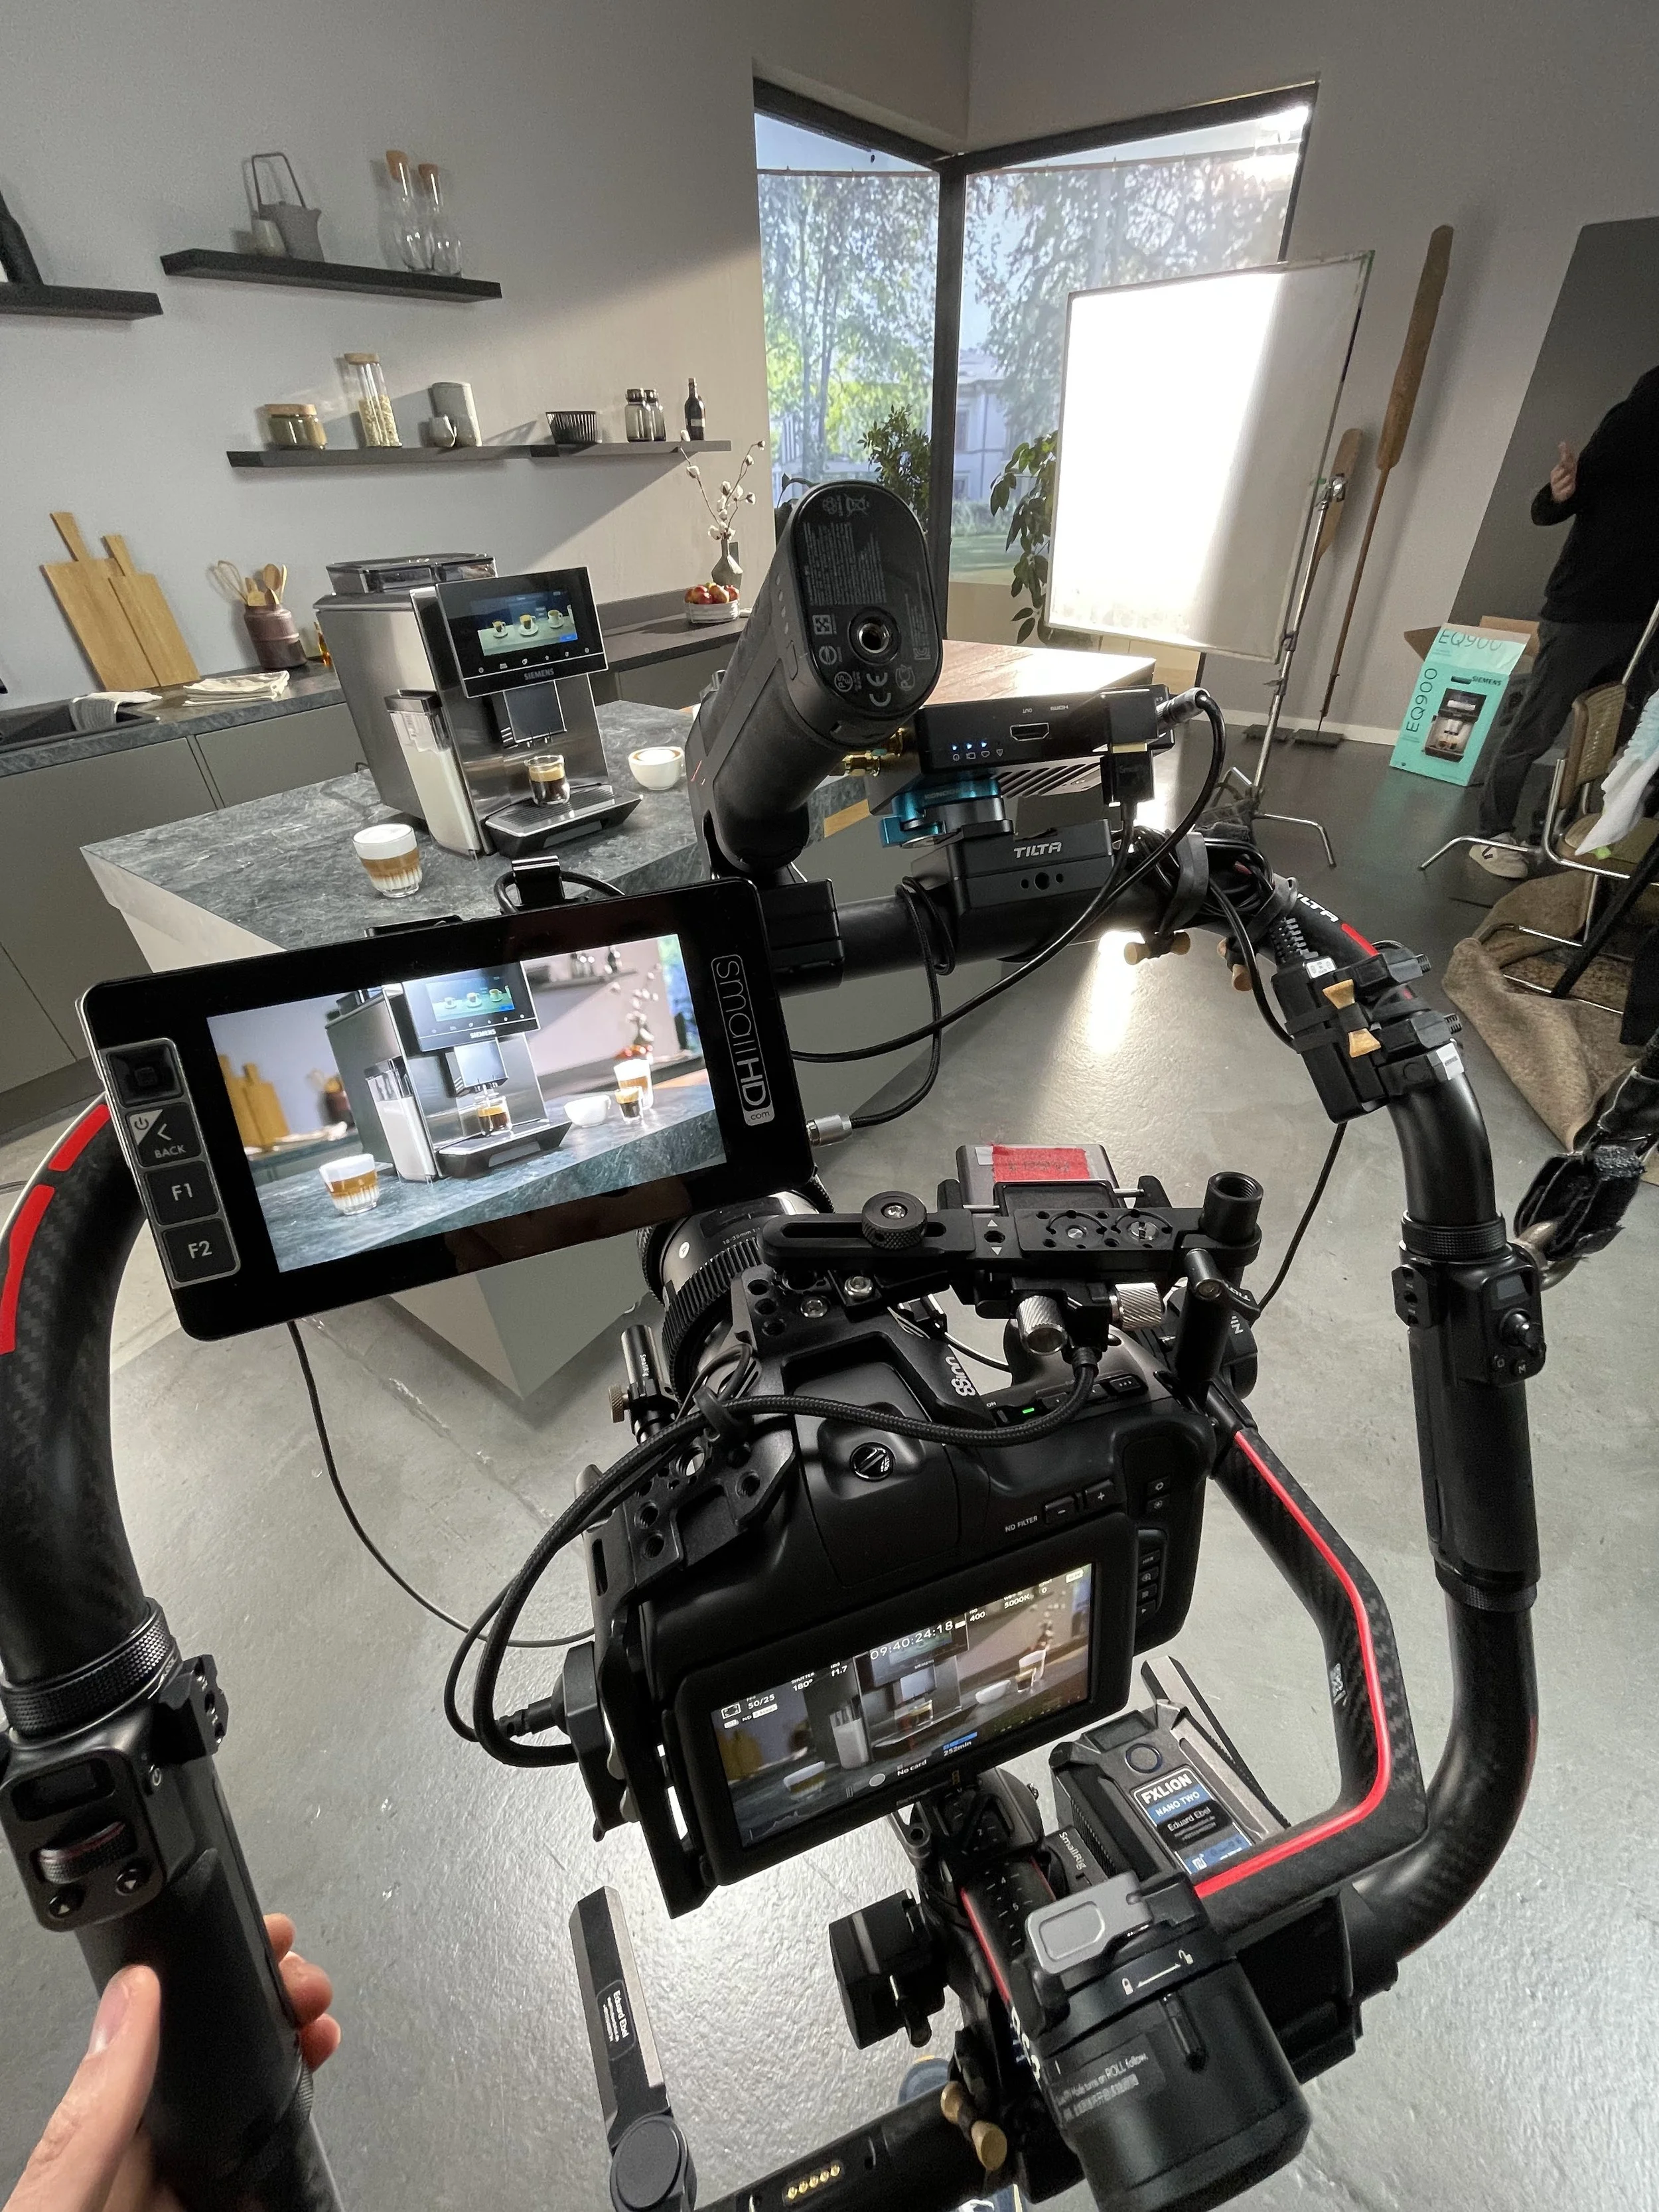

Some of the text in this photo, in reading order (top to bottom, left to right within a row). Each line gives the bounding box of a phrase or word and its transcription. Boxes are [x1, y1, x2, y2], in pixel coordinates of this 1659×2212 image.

[524, 668, 555, 680] SIEMENS
[1471, 676, 1502, 686] SIEMENS
[1406, 668, 1438, 732] EQ900
[1014, 842, 1062, 859] TILTA
[1296, 893, 1340, 923] ILTA
[470, 1028, 497, 1039] SIEMENS
[747, 1110, 770, 1123] .com
[154, 1144, 186, 1159] BACK
[171, 1183, 193, 1201] F1
[188, 1240, 213, 1259] F2
[945, 1356, 976, 1396] 8Sinn
[1005, 1515, 1038, 1533] ND FILTER
[1004, 1593, 1031, 1609] 5000K
[970, 1611, 986, 1622] 400
[870, 1620, 954, 1660] 09:40:24:18
[791, 1672, 815, 1684] SHUTTER
[831, 1664, 847, 1677] f1.7
[747, 1694, 775, 1710] 50/25
[943, 1741, 972, 1757] 252min
[897, 1759, 927, 1777] No card
[1141, 1773, 1192, 1805] FXLION
[1155, 1791, 1200, 1816] NANO TWO
[1167, 1816, 1194, 1832] Eduard
[1058, 1831, 1087, 1870] SmallRig
[613, 1990, 626, 2020] Eduard
[1104, 2061, 1127, 2079] ROLL
